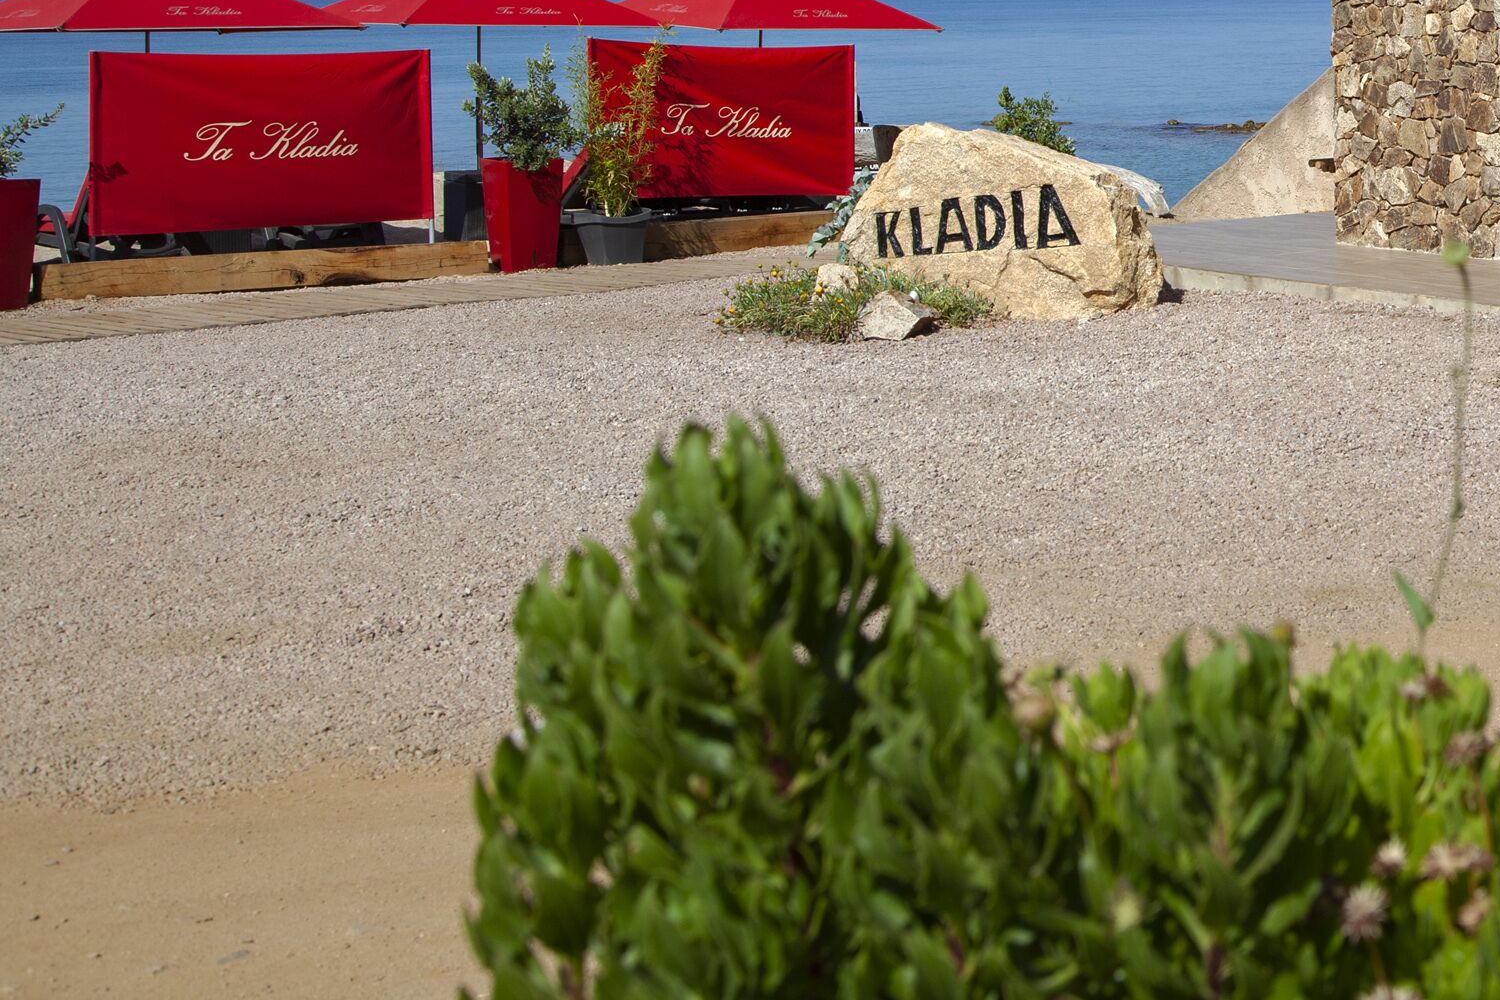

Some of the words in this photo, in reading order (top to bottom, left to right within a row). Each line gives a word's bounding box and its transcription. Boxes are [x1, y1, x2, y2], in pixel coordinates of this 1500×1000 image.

[183, 119, 252, 162] Ta
[249, 120, 359, 161] Kladia
[660, 102, 711, 137] Ta
[705, 106, 792, 139] Kladia
[874, 183, 1082, 259] KLADIA
